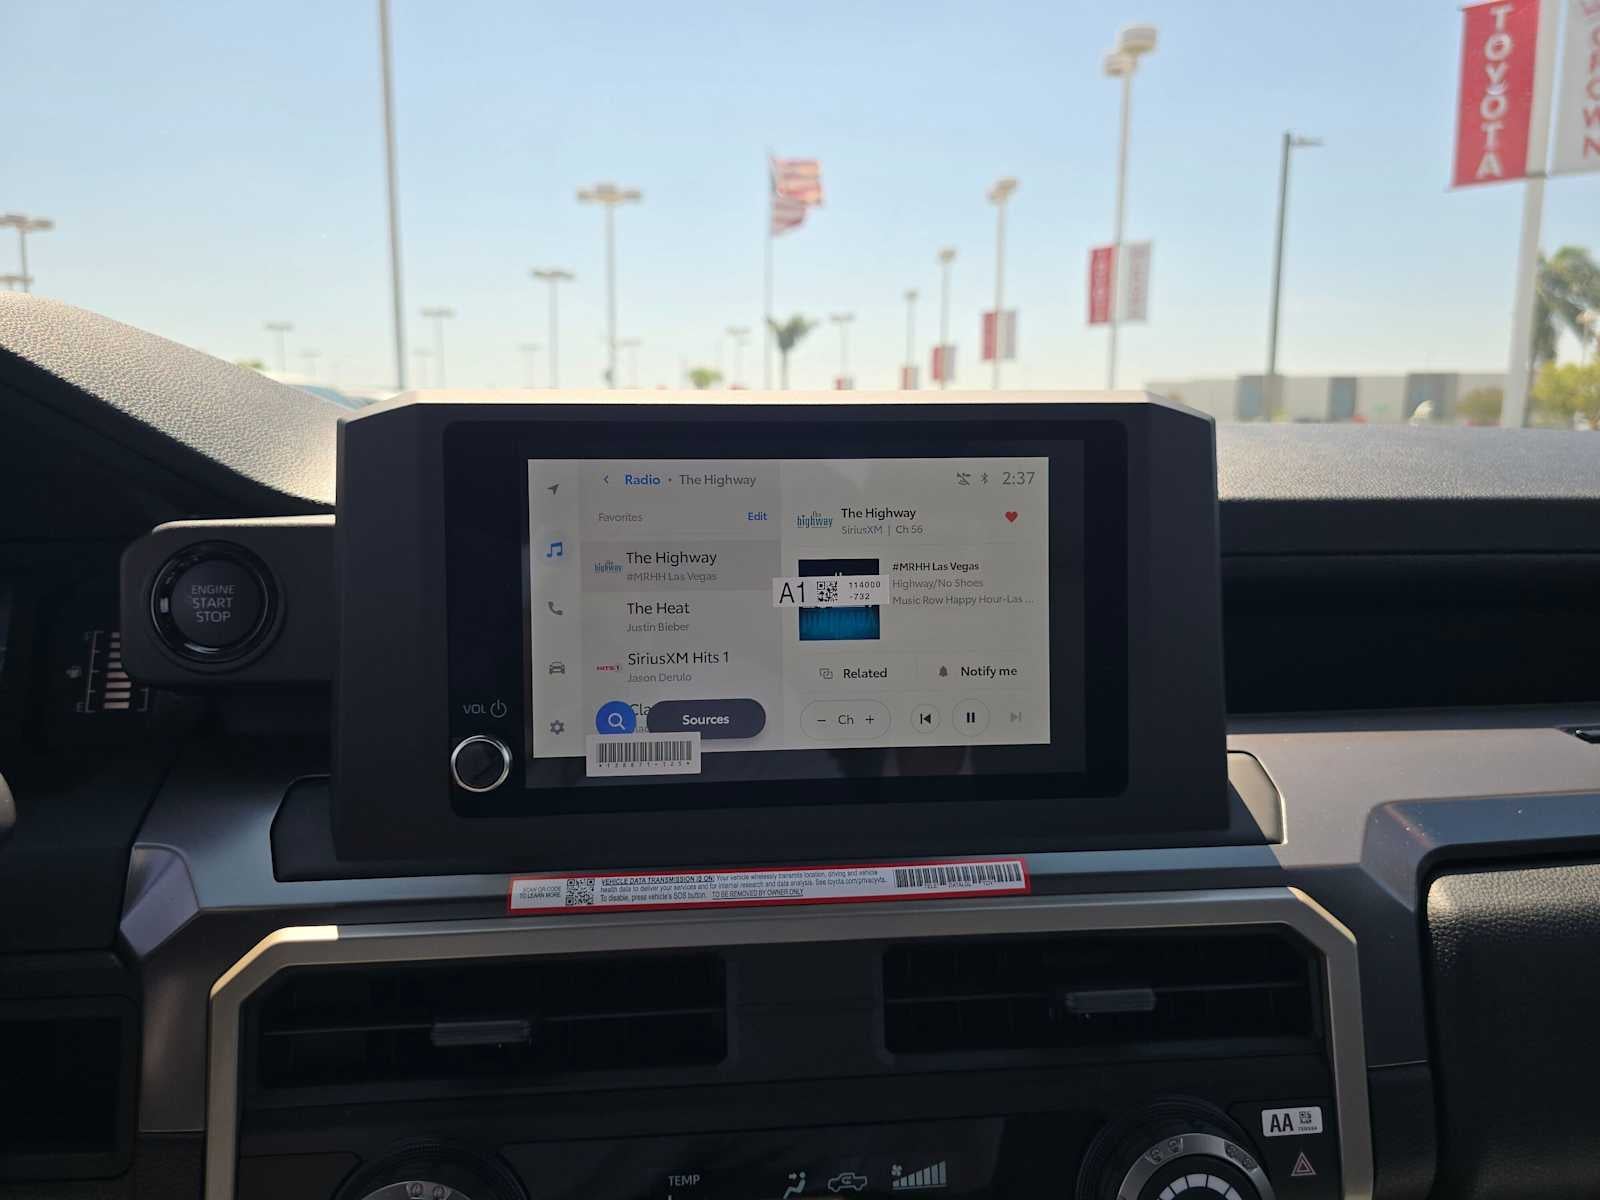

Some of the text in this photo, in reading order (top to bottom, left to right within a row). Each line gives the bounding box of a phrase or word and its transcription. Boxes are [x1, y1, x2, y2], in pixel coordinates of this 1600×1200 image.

[1474, 4, 1514, 179] TOYOTA
[625, 473, 756, 489] Radio The Highway
[1002, 471, 1035, 485] 2:37
[598, 512, 643, 523] Favorites
[747, 511, 768, 521] Edit
[841, 507, 916, 522] The Highway
[797, 514, 833, 529] highway
[841, 524, 923, 535] SiriusXM Ch 56
[626, 551, 717, 567] The Highway
[892, 561, 980, 573] #MRHH Las Vegas
[627, 571, 717, 584] #MRHH Las Vegas
[955, 577, 984, 588] Shoes
[191, 584, 236, 595] ENGINE
[779, 582, 805, 604] A1
[192, 597, 233, 609] START
[893, 595, 920, 605] Music
[922, 595, 944, 605] Row
[945, 594, 977, 607] Happy
[627, 602, 690, 615] The Heat
[195, 611, 231, 623] STOP
[627, 621, 689, 633] Justin Bieber
[628, 651, 729, 665] SiriusXM Hits 1
[627, 672, 692, 684] Jason Derulo
[843, 668, 888, 679] Related
[961, 666, 1018, 679] Notify me
[463, 704, 486, 714] VOL
[682, 714, 730, 726] Sources
[838, 715, 854, 725] Ch
[1270, 1113, 1294, 1132] AA
[668, 1174, 701, 1186] TEMP
